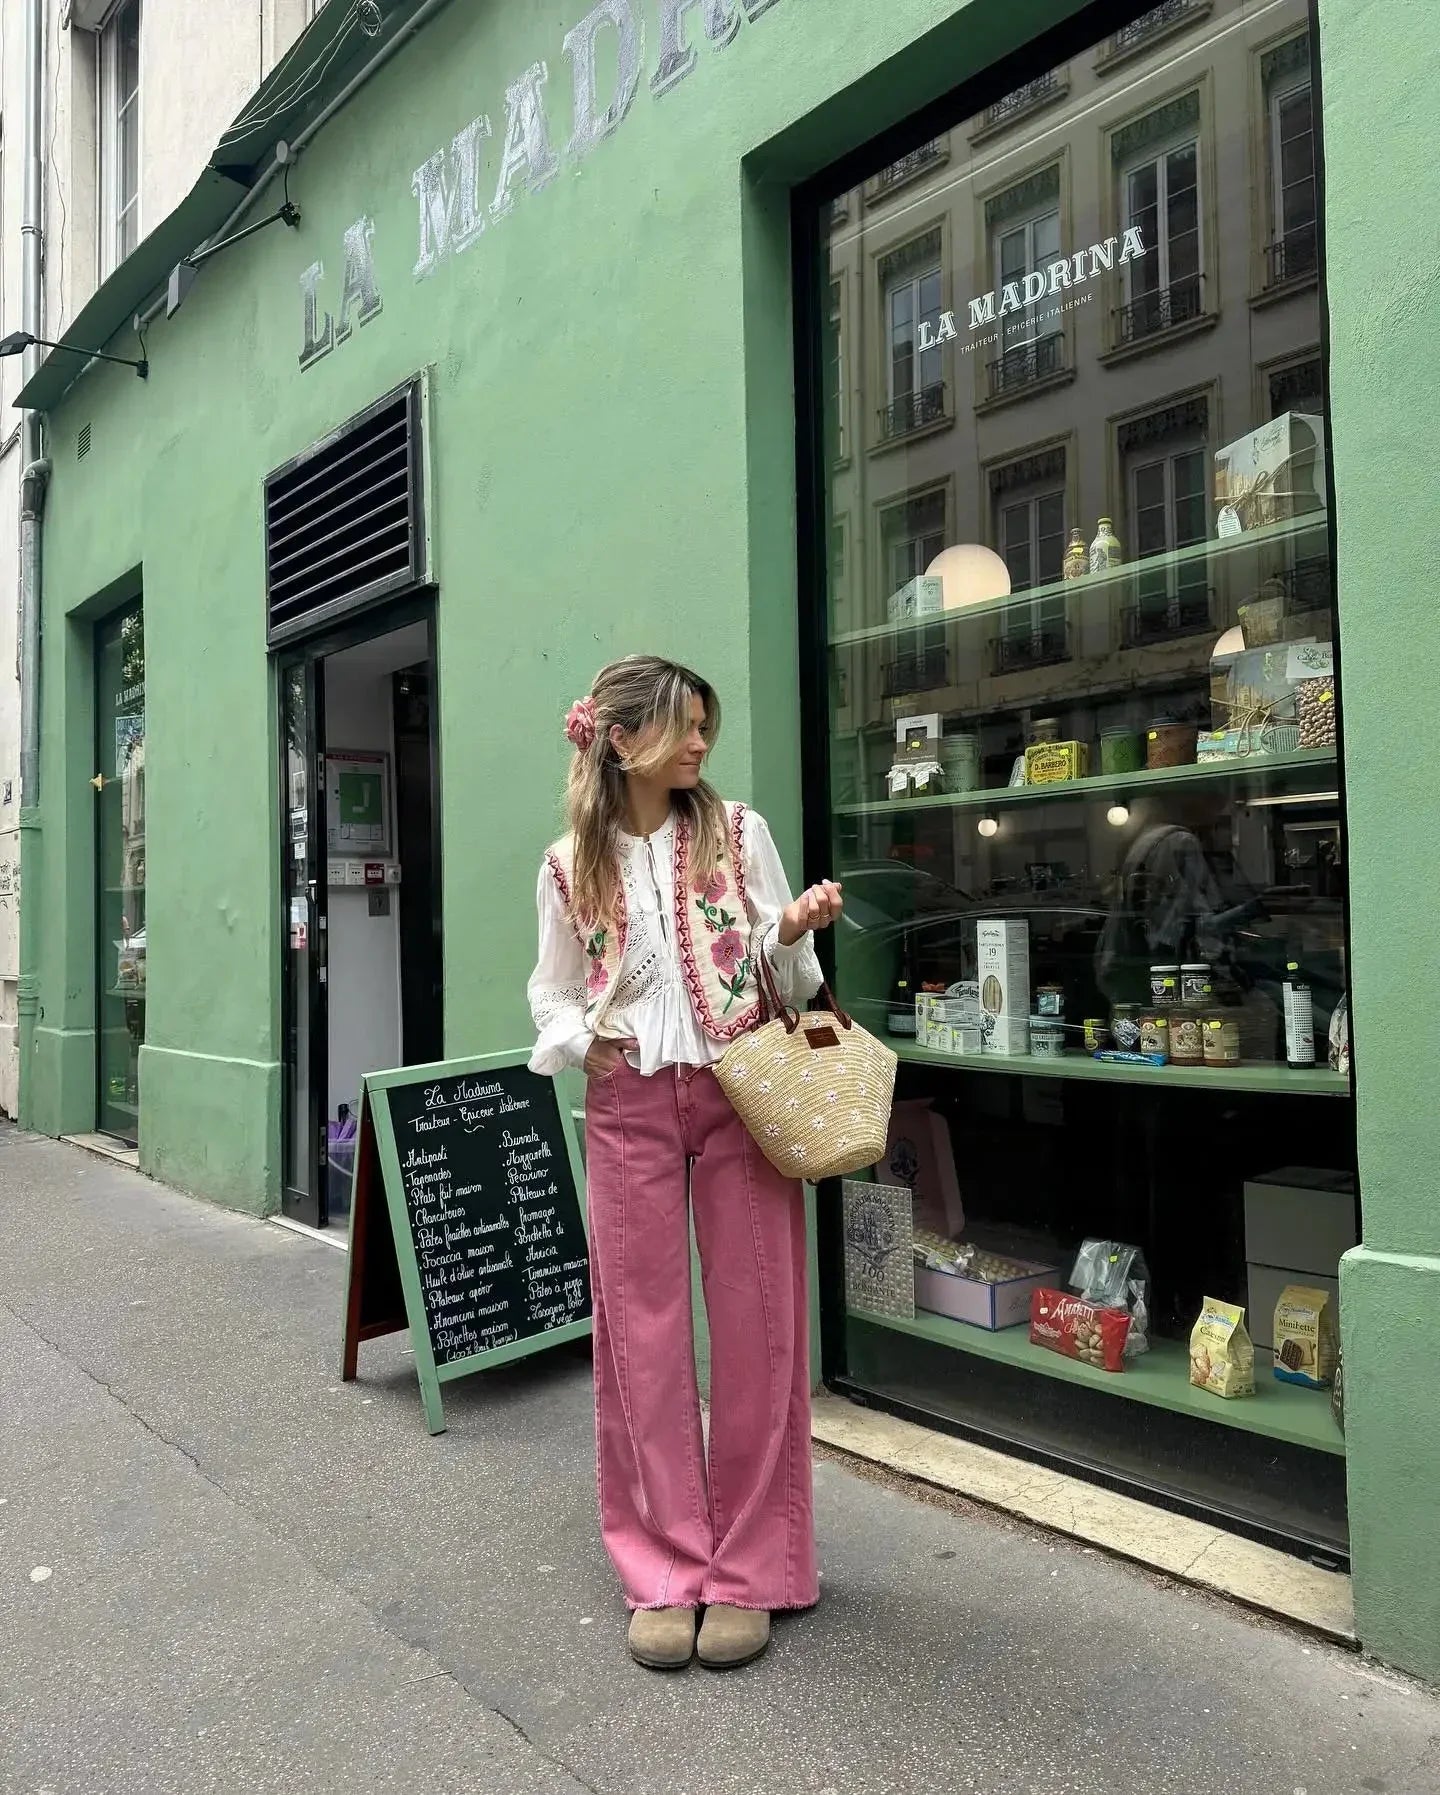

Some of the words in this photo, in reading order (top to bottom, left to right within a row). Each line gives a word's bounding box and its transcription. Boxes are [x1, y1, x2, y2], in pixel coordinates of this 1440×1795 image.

[299, 215, 384, 373] LA
[917, 310, 958, 352] LA
[968, 225, 1148, 331] MADRINA
[961, 334, 999, 355] TRAITEUR
[1007, 315, 1045, 335] EPICERIE
[1046, 293, 1093, 318] ITALIENNE
[424, 1085, 447, 1107] La
[453, 1080, 505, 1102] Madrina
[408, 1114, 451, 1133] Traiteur
[502, 1126, 540, 1148] Burrata
[406, 1144, 448, 1168] Antipasti
[506, 1141, 553, 1171] Mozzarella
[405, 1167, 452, 1190] Tapenades
[411, 1187, 436, 1206] Plats
[440, 1182, 453, 1210] fait
[456, 1182, 482, 1198] maison
[510, 1185, 546, 1204] Plateaux
[548, 1181, 559, 1195] de
[416, 1204, 466, 1227] Charcuteries
[556, 1221, 565, 1236] di
[421, 1248, 464, 1270] Focaccia
[467, 1243, 495, 1259] maison
[425, 1267, 448, 1289] Huile
[450, 1263, 475, 1283] d'olive
[860, 1262, 885, 1282] 100
[429, 1289, 465, 1309] Plateaux
[433, 1311, 476, 1330] Arancini
[478, 1299, 509, 1317] maison
[436, 1324, 478, 1350] Polpettes
[480, 1320, 509, 1337] maison
